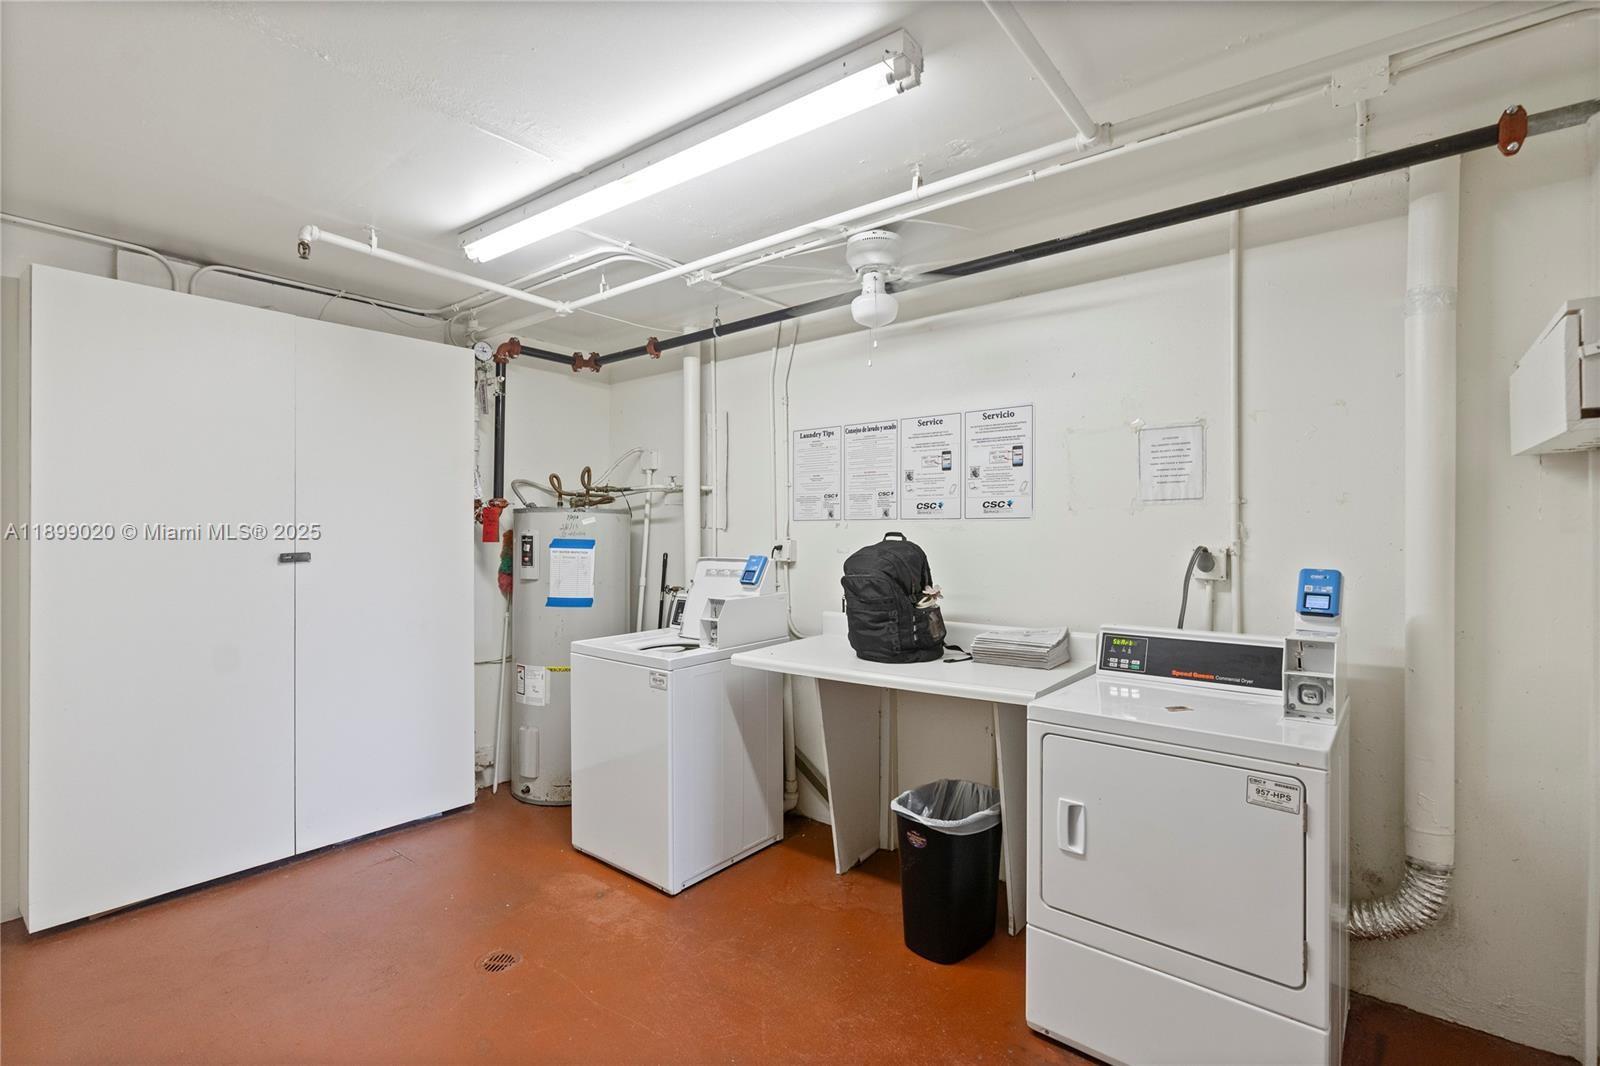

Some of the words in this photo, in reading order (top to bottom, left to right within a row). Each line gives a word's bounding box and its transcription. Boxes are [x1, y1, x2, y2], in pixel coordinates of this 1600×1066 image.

[982, 410, 1015, 421] Servicio
[917, 417, 944, 428] Service
[800, 431, 822, 440] Laundry
[822, 430, 835, 439] Tips
[916, 502, 937, 510] CSC
[982, 500, 1006, 508] CSC
[1171, 669, 1193, 677] Speed
[1241, 678, 1254, 686] Dryer
[1255, 787, 1292, 802] 957-HPS
